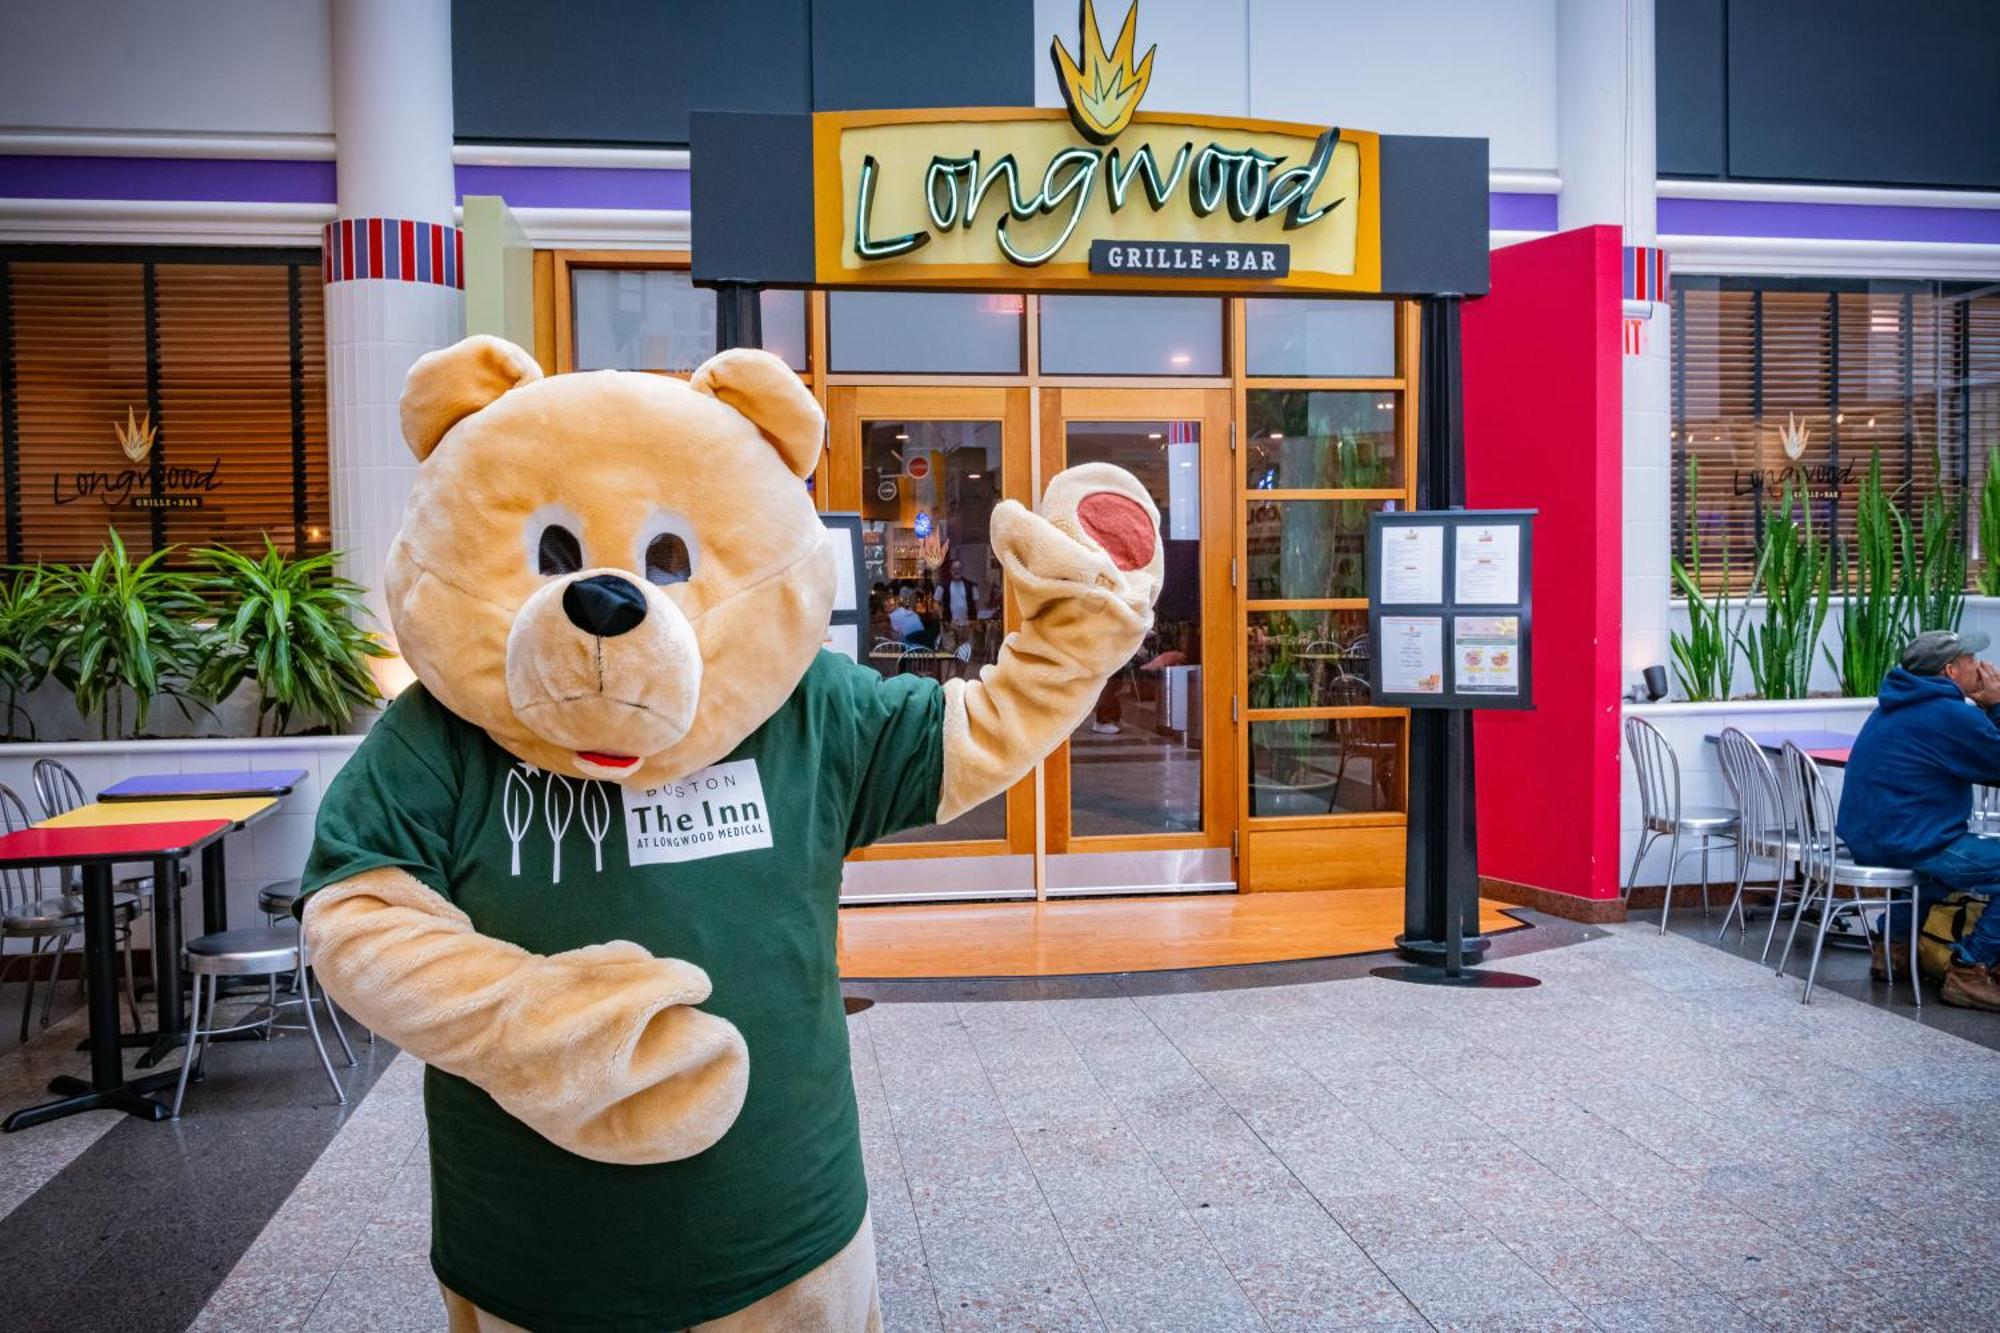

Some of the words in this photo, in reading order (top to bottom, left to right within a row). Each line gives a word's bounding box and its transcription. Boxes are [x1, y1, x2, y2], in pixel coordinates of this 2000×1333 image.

[855, 127, 1345, 268] Longwood
[631, 804, 694, 833] The
[702, 799, 760, 827] Inn
[637, 838, 649, 849] AT
[654, 831, 714, 848] LONGWOOD
[718, 823, 764, 839] MEDICAL
